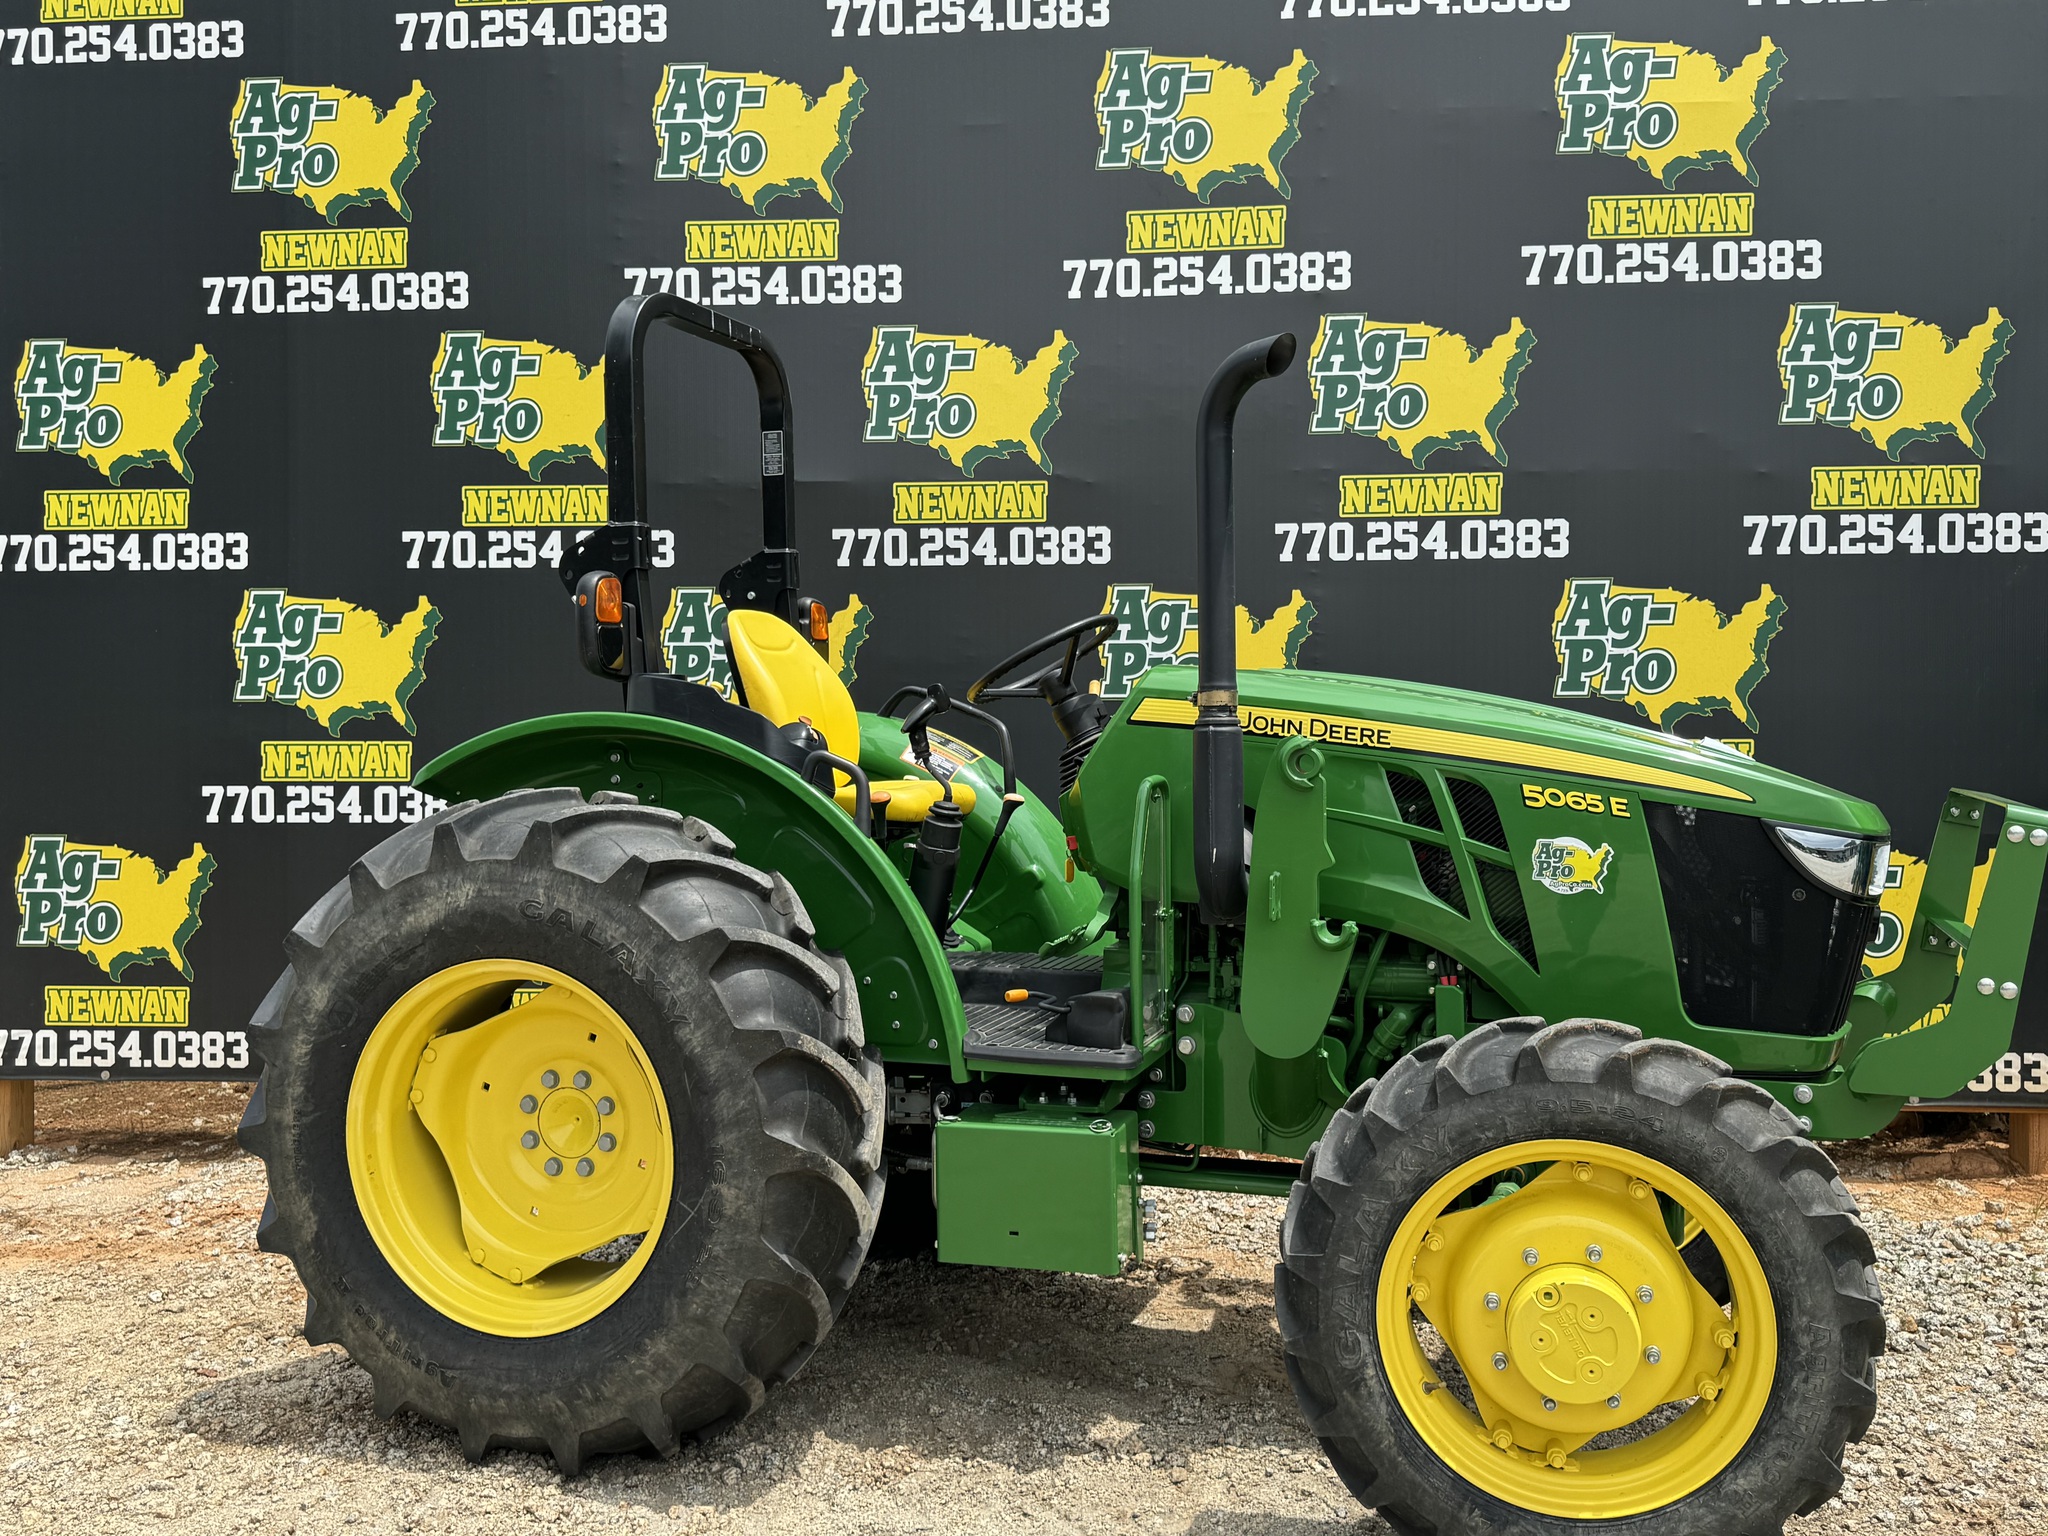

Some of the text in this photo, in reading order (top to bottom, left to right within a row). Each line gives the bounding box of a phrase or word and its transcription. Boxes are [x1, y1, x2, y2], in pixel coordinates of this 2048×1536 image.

[0, 20, 244, 65] 70.254.0383
[396, 4, 667, 51] 770.254.0383
[827, 0, 1109, 37] 770.254.0383
[1099, 50, 1211, 120] Ag-
[1559, 35, 1676, 105] Ag-
[234, 80, 338, 145] Ag-
[657, 65, 766, 133] Ag-
[1559, 91, 1675, 151] Pro
[657, 119, 765, 178] Pro
[1099, 106, 1210, 166] Pro
[235, 133, 337, 189] Pro
[1129, 210, 1283, 249] NEWNAN
[1591, 198, 1751, 235] NEWNAN
[264, 232, 405, 267] NEWNAN
[689, 224, 836, 258] NEWNAN
[1522, 240, 1821, 285] 770.254.0383
[203, 271, 468, 314] 770.254.0383
[624, 264, 902, 306] 770.254.0383
[1063, 251, 1351, 299] 770.254.0383
[866, 328, 975, 395] Ag-
[1313, 316, 1427, 386] Ag-
[1782, 305, 1901, 375] Ag-
[19, 342, 121, 406] Ag-
[435, 334, 541, 400] Ag-
[436, 387, 540, 444] Pro
[866, 382, 974, 440] Pro
[1313, 372, 1426, 432] Pro
[1783, 361, 1900, 422] Pro
[20, 393, 120, 448] Pro
[47, 493, 186, 526] NEWNAN
[465, 489, 608, 522] NEWNAN
[897, 485, 1045, 519] NEWNAN
[1343, 476, 1500, 513] NEWNAN
[1815, 470, 1978, 506] NEWNAN
[832, 526, 1111, 566] 770.254.0383
[1275, 519, 1569, 561] 770.254.0383
[1744, 512, 2048, 555] 770.254.0383
[237, 592, 342, 657] Ag-
[1558, 581, 1675, 650] Ag-
[238, 644, 341, 700] Pro
[1558, 636, 1674, 696] Pro
[1240, 712, 1392, 746] JOHN DEERE
[264, 745, 409, 777] NEWNAN
[202, 786, 448, 823] 770.254.03
[1521, 783, 1632, 819] 5065 E
[21, 837, 121, 900] Ag-
[1535, 841, 1575, 865] Ag-
[1535, 859, 1575, 879] Pro
[22, 888, 120, 942] Pro
[517, 898, 693, 1024] GALAXY
[48, 990, 187, 1022] NEWNAN
